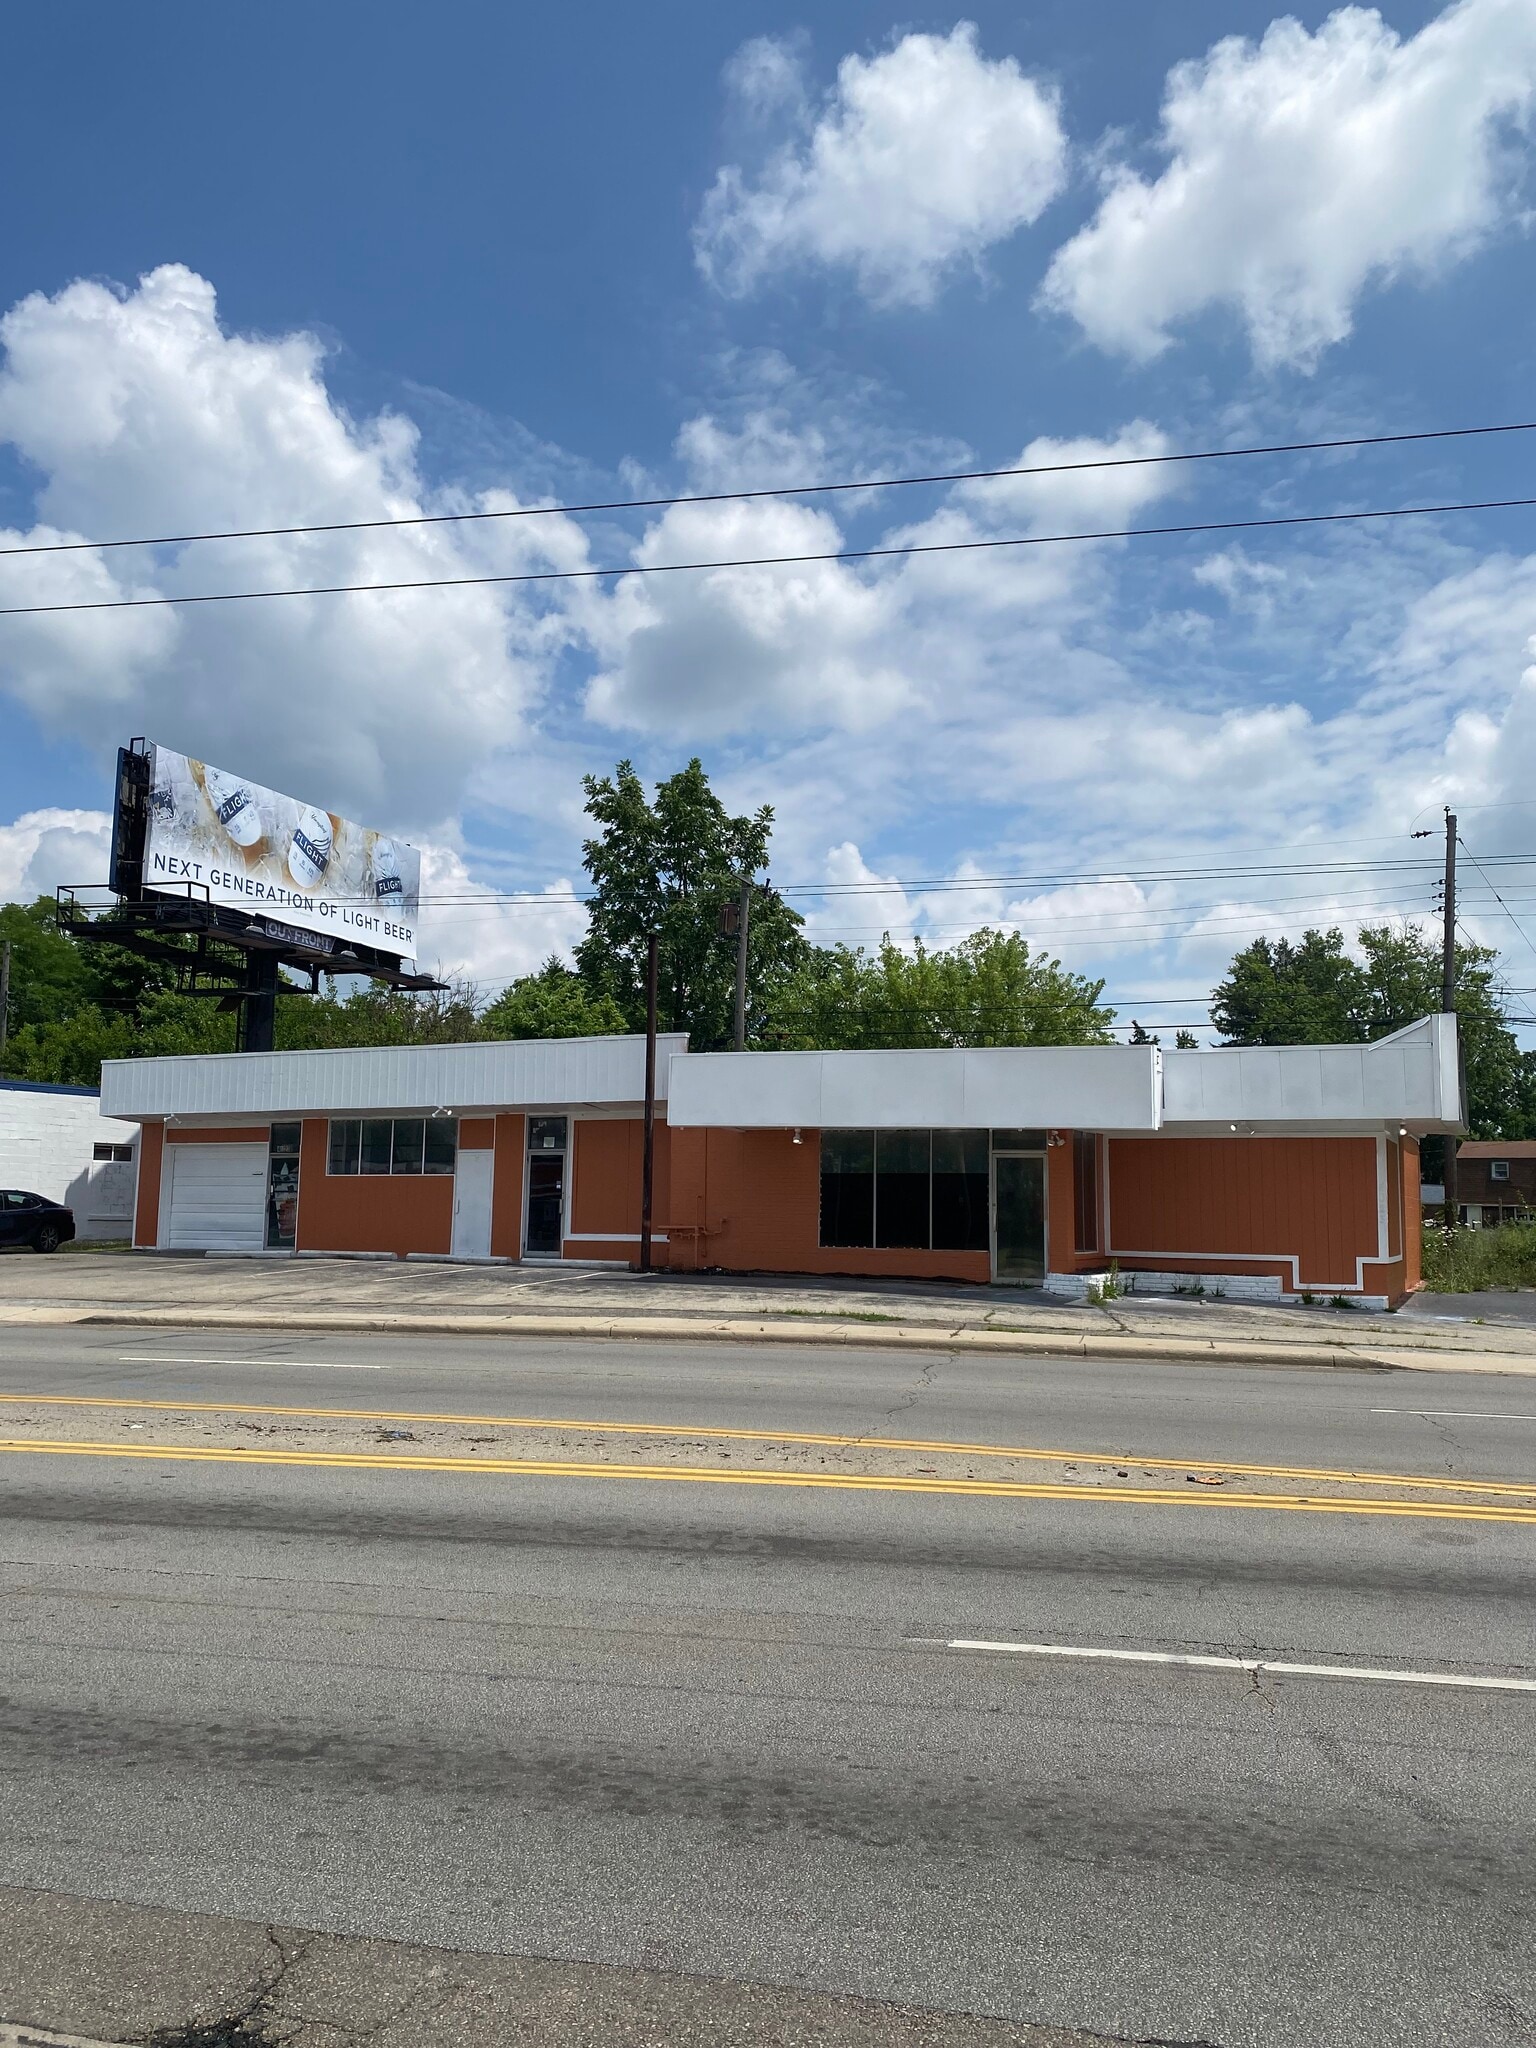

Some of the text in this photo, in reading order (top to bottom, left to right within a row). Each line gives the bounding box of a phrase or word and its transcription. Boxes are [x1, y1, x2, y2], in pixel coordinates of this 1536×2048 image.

[296, 832, 323, 865] FLIGHT
[154, 853, 412, 943] NEXT GENERATION OF LIGHT BEER
